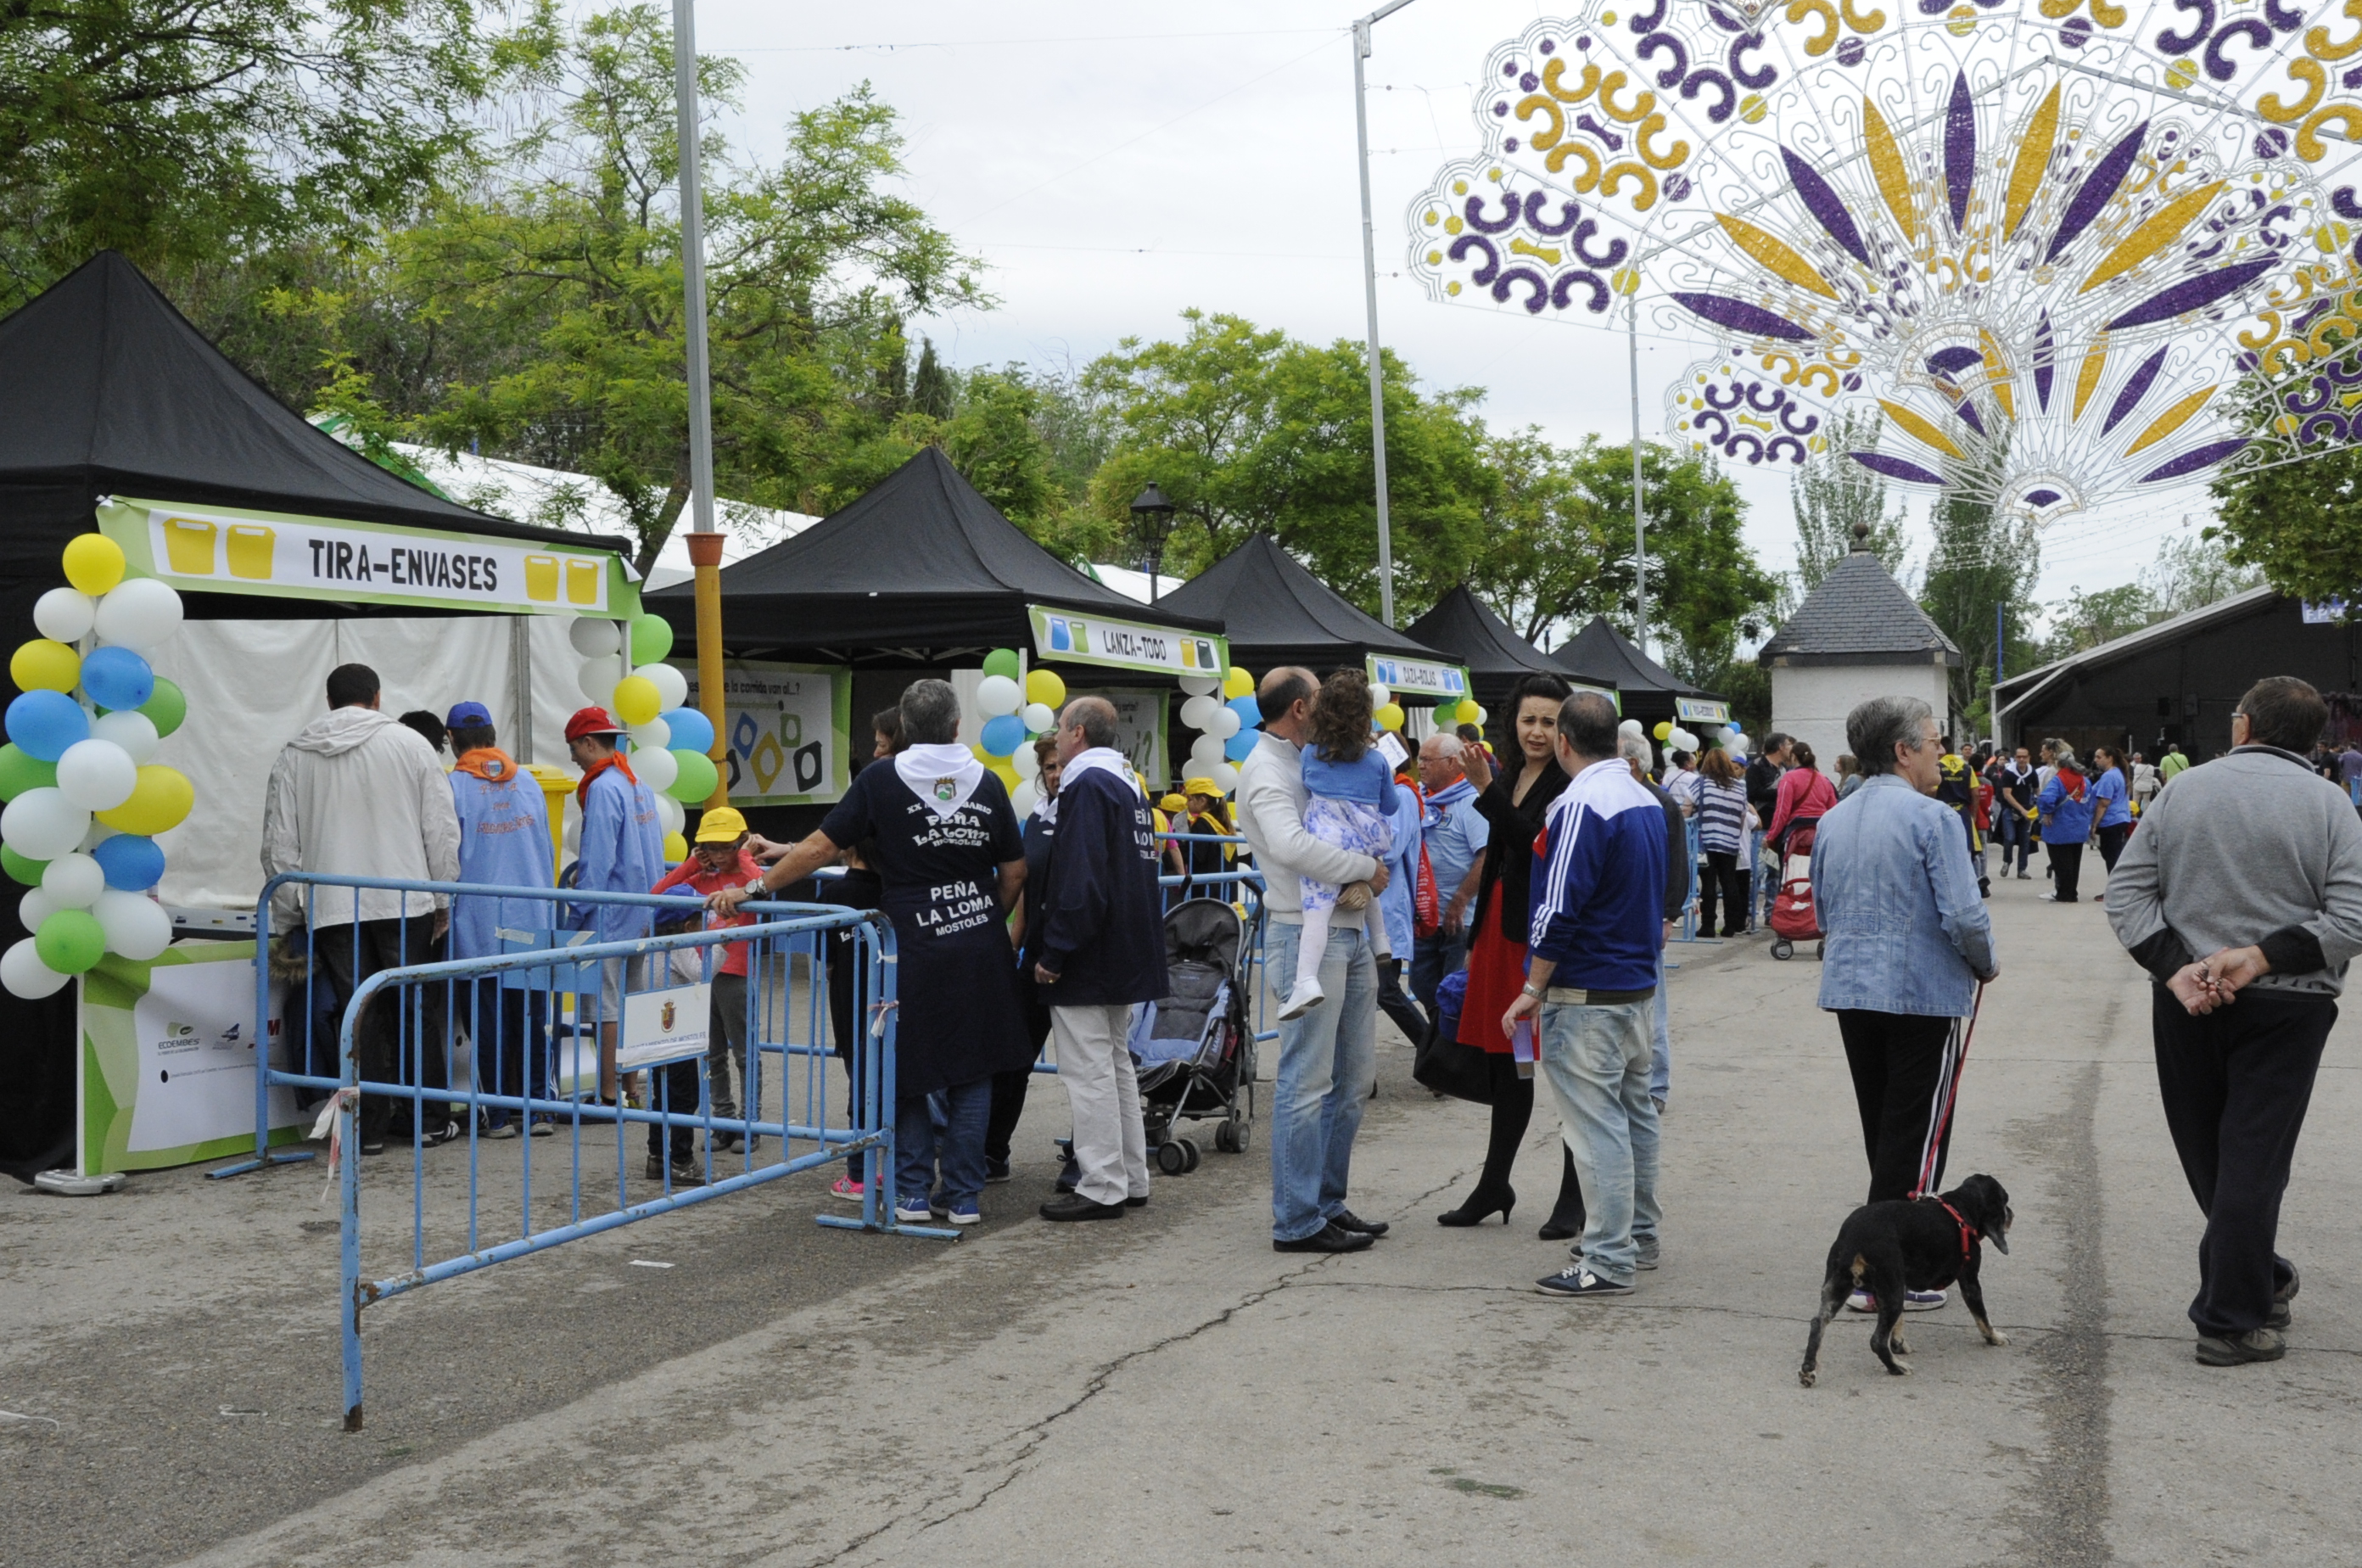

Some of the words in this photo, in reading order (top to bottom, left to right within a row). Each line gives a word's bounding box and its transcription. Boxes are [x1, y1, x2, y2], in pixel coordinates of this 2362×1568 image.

[308, 539, 498, 592] TIRA-ENVASES
[1103, 630, 1167, 661] LANZA-TODO
[930, 881, 979, 902] PEÑA
[916, 909, 943, 927] LA
[947, 895, 993, 919] LOMA
[935, 914, 988, 937] MOSTOLES
